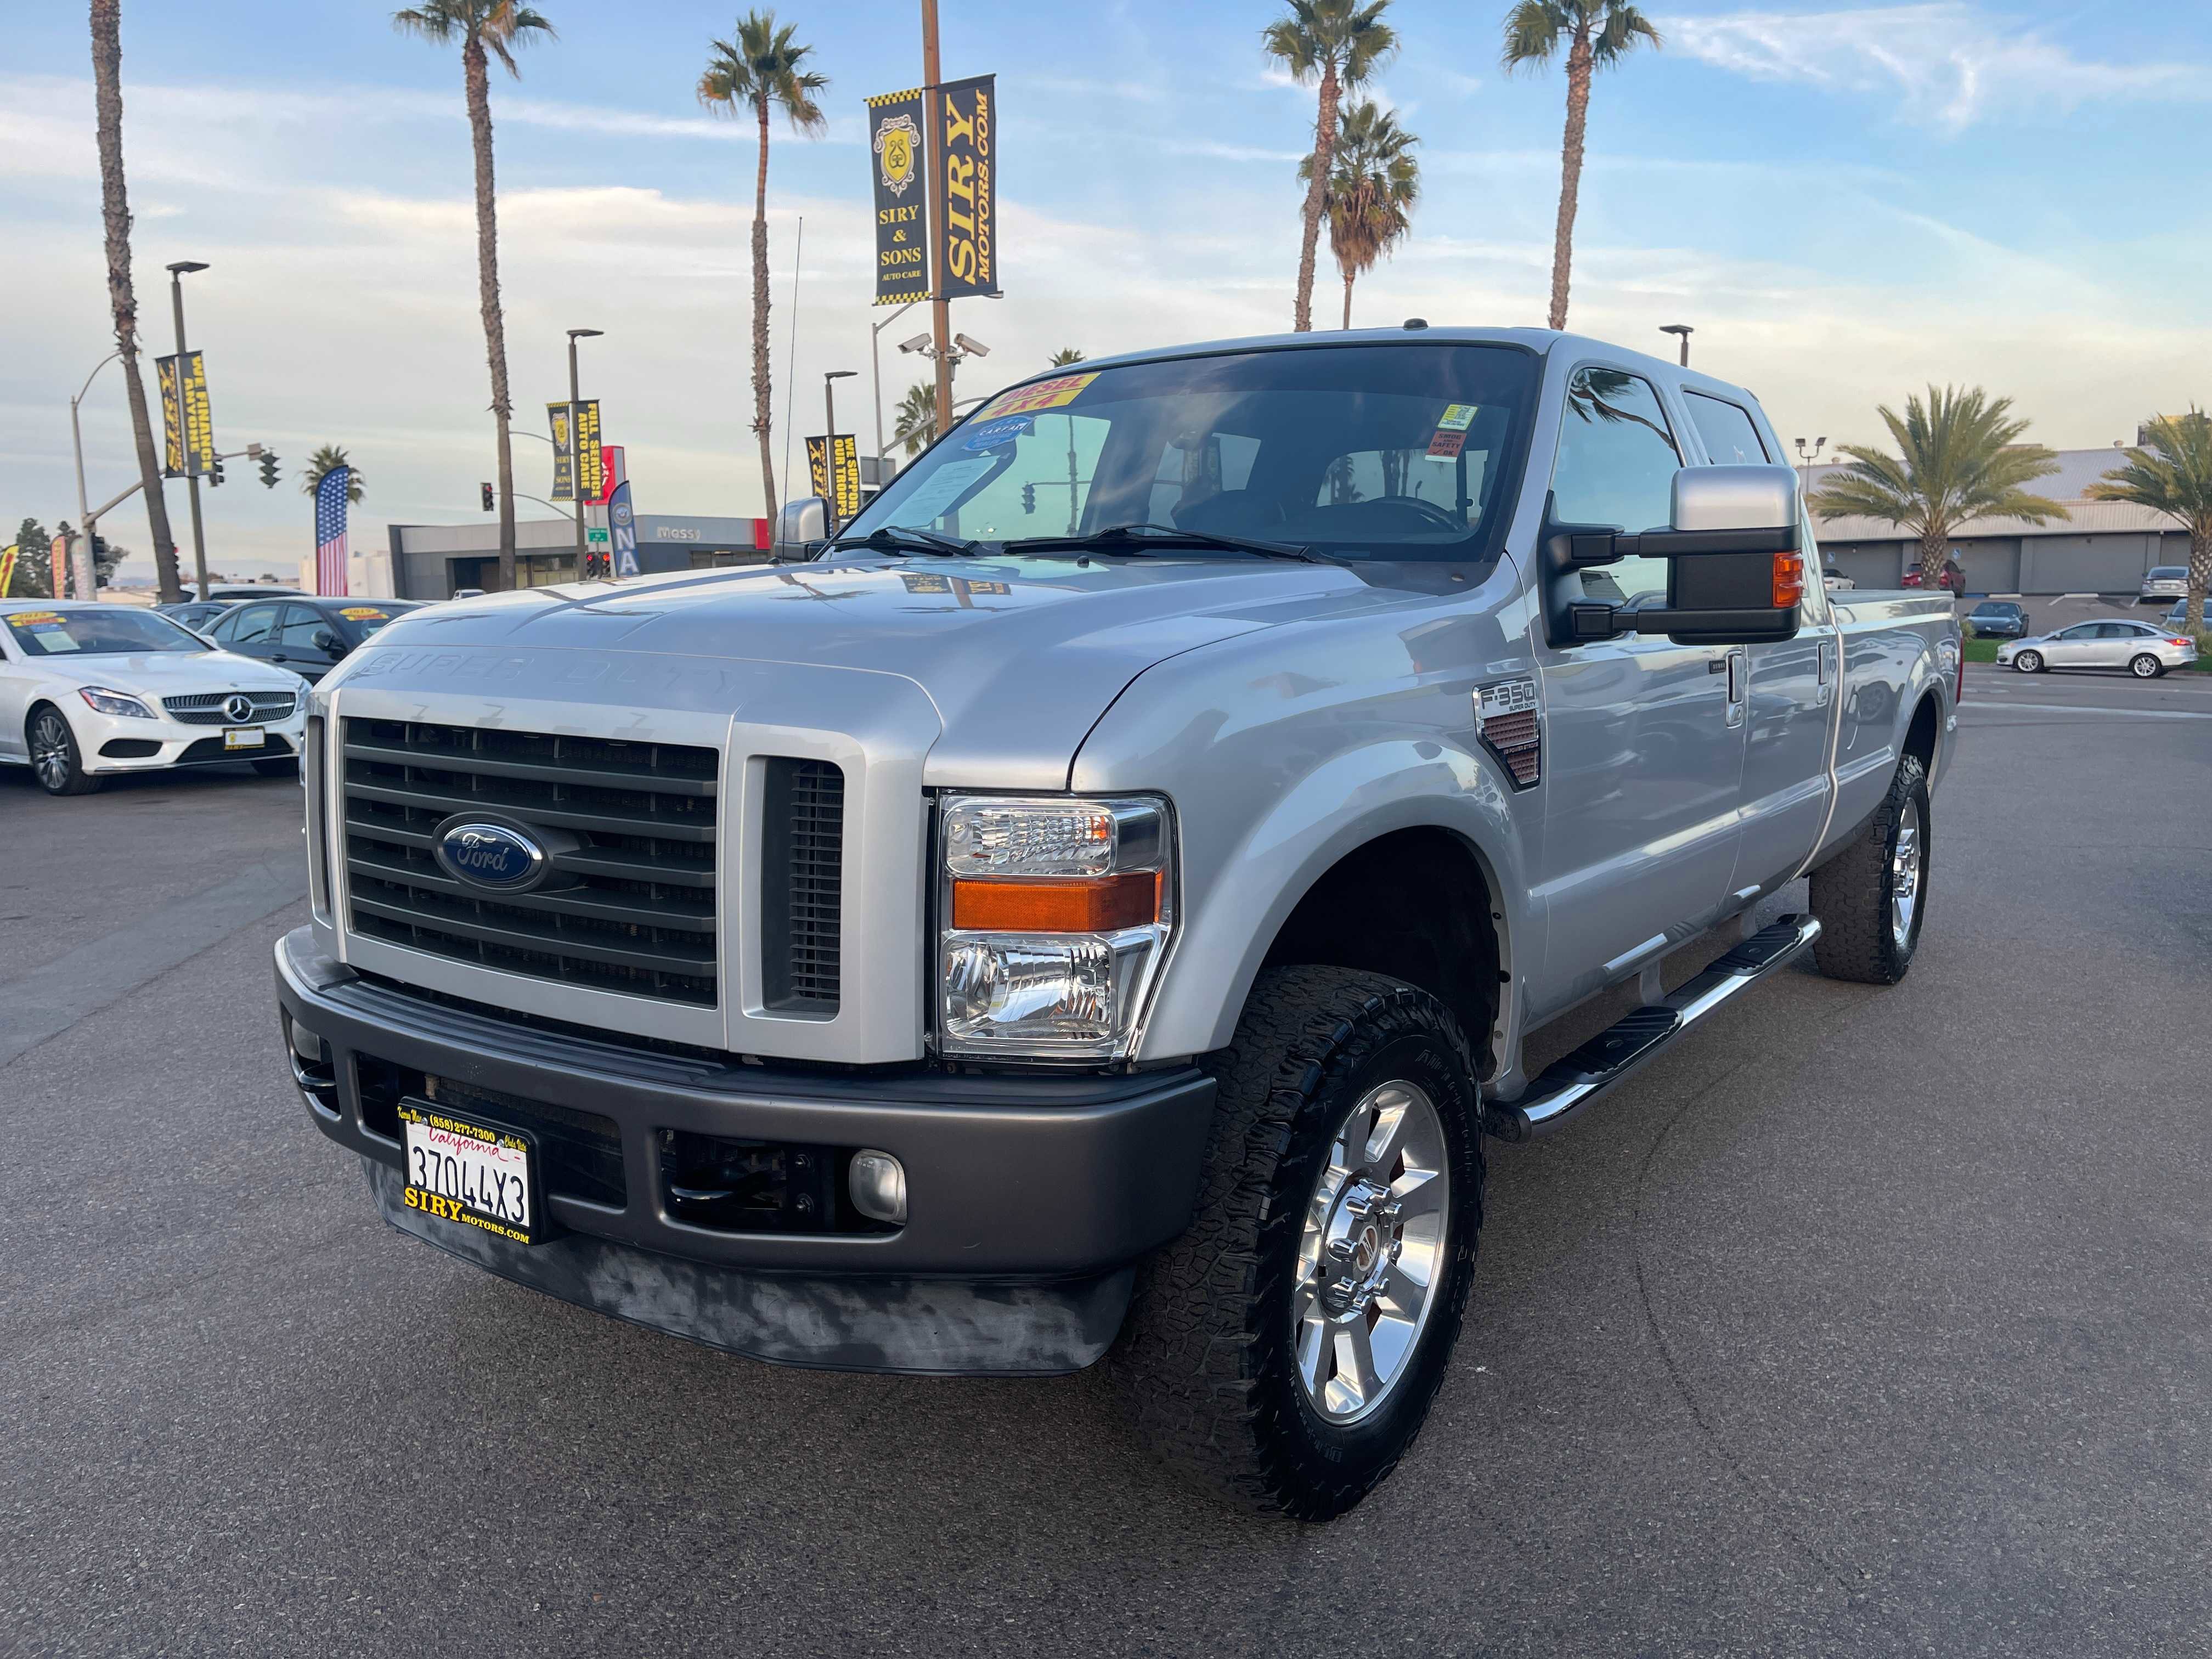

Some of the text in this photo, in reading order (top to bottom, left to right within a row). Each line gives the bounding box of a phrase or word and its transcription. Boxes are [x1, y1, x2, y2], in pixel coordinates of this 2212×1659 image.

[879, 205, 919, 224] SIRY
[946, 93, 977, 286] SIRY
[975, 88, 990, 283] MOTORS.COM
[881, 247, 921, 266] SONS
[893, 229, 906, 242] &
[882, 270, 921, 281] AUTO CARE
[184, 377, 200, 453] ANYONE
[192, 355, 213, 472] WE FINANCE
[578, 413, 590, 489] AUTO CARE
[588, 403, 601, 498] FULL SERVICE
[809, 440, 824, 499] IRY
[834, 439, 847, 516] OUR TROOPS
[844, 437, 859, 515] WE SUPPORT
[658, 526, 701, 542] Mossy
[1481, 683, 1535, 710] F-350
[456, 832, 510, 872] Ford
[429, 1127, 509, 1161] California
[430, 1114, 495, 1142] (858) 277-7300
[413, 1146, 525, 1223] 37044X3
[404, 1187, 530, 1245] SIRY MOTORS.COM
